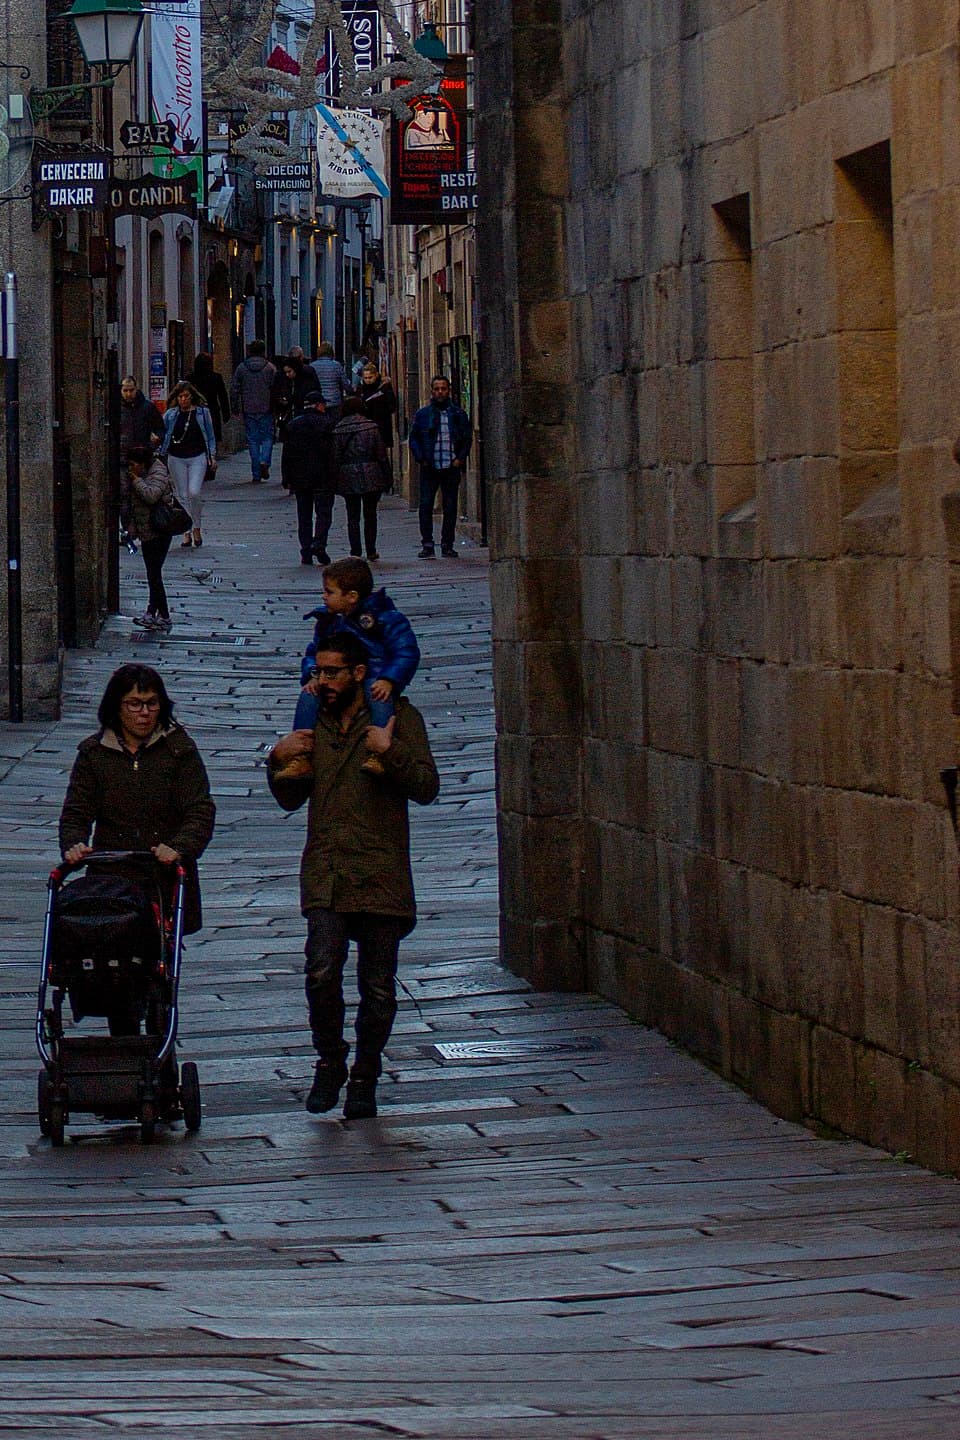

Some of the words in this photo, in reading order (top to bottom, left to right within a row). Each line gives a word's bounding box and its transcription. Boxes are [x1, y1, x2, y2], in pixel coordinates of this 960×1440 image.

[127, 124, 171, 144] BAR
[238, 122, 288, 138] BAROLA
[41, 162, 105, 181] CERVECERIA
[265, 165, 309, 176] ODEGON
[328, 161, 373, 175] RIBADAVIA
[255, 178, 311, 189] SANTIAGUIÑO
[50, 187, 94, 205] DAKAR
[111, 189, 122, 207] O
[129, 185, 189, 206] CANDIL
[442, 195, 470, 209] BAR
